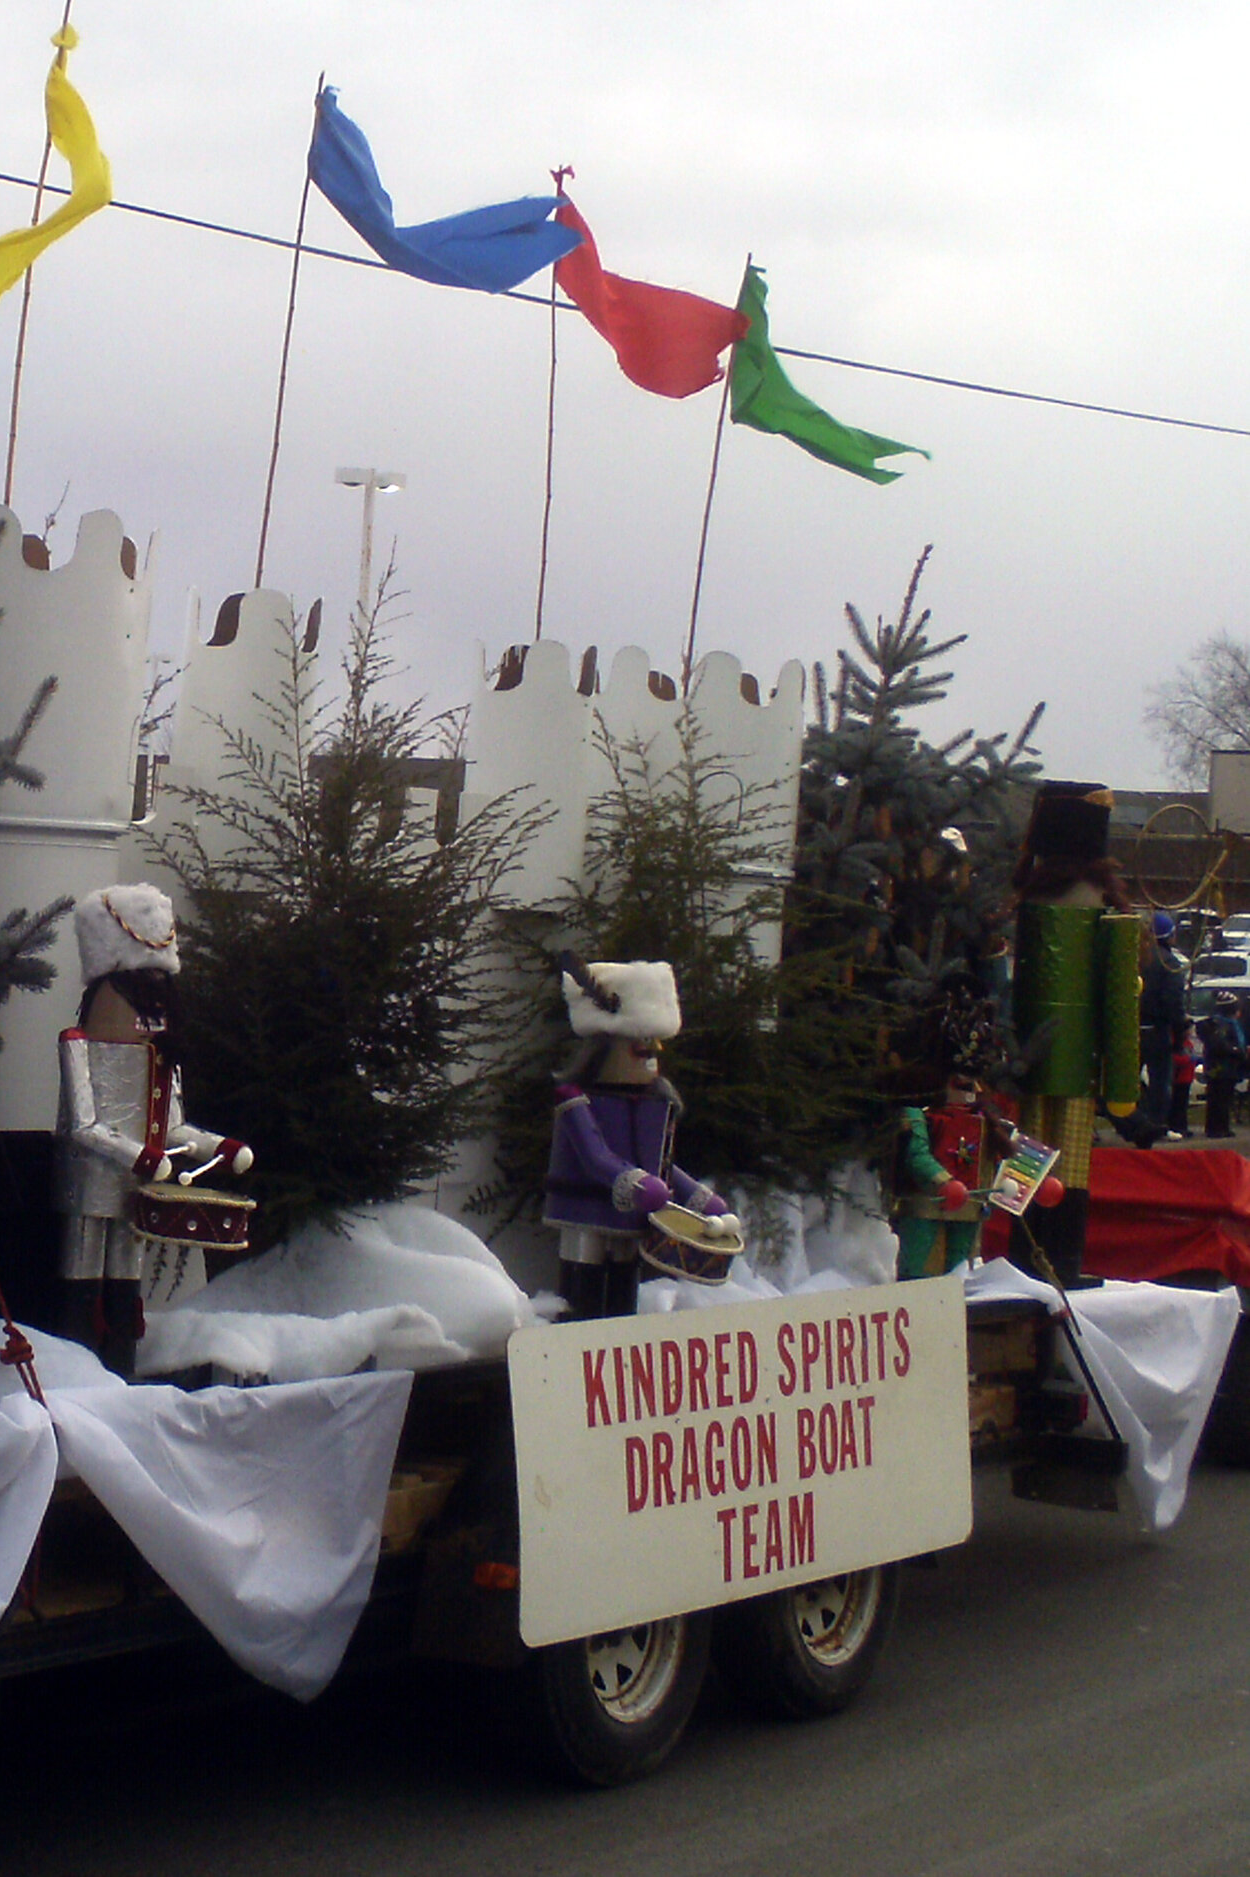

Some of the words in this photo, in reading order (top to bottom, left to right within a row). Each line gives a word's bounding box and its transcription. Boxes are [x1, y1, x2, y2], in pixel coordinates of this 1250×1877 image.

[583, 1331, 758, 1428] KINDRED
[777, 1307, 911, 1397] SPIRITS
[625, 1411, 778, 1514] DRAGON
[797, 1396, 875, 1480] BOAT
[717, 1491, 816, 1583] TEAM
